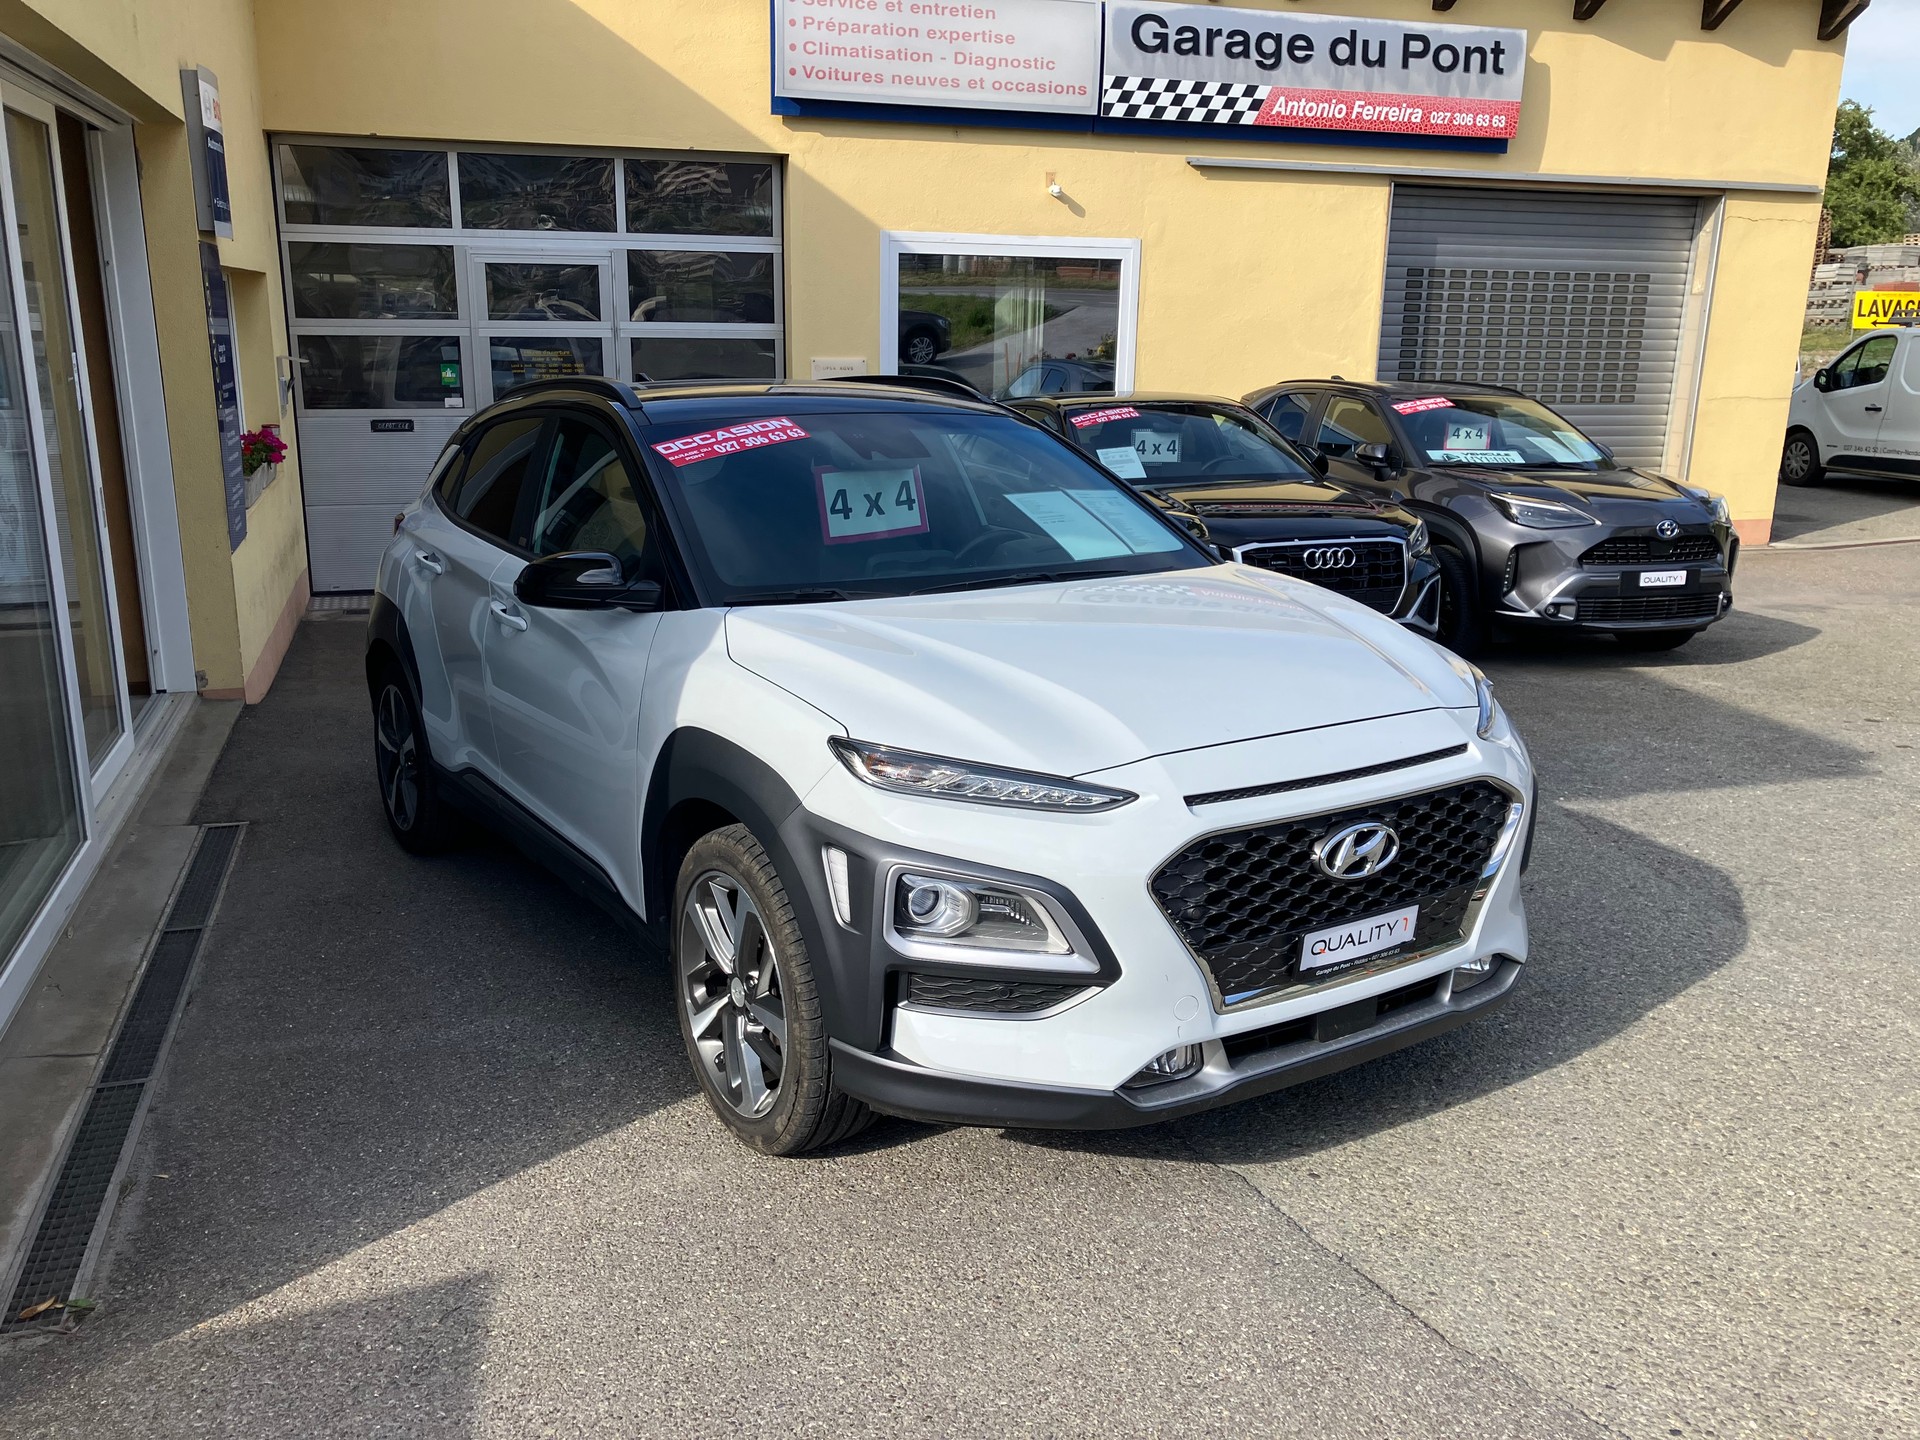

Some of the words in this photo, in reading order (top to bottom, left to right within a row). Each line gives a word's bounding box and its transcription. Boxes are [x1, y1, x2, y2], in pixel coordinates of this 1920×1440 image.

[885, 0, 903, 13] et
[910, 3, 996, 20] entretien
[803, 16, 919, 38] Préparation
[926, 28, 1016, 45] expertise
[802, 41, 933, 63] Climatisation
[954, 51, 1056, 71] Diagnostic
[1131, 13, 1314, 71] Garage
[1329, 29, 1387, 68] du
[1401, 33, 1506, 75] Pont
[802, 65, 884, 84] Voitures
[891, 74, 960, 88] neuves
[967, 77, 985, 90] et
[991, 80, 1088, 96] occasions
[1271, 96, 1347, 119] Antonio
[1351, 100, 1423, 123] Ferreira
[1430, 111, 1451, 125] 027
[1453, 112, 1474, 126] 306
[1475, 113, 1490, 127] 63
[1492, 115, 1506, 128] 63
[1857, 299, 1920, 318] LAVAG
[1070, 407, 1135, 423] OCCASION
[1391, 397, 1449, 410] OCCASION
[655, 418, 794, 454] OCCASION
[713, 440, 741, 454] 027
[740, 434, 769, 448] 306
[769, 431, 788, 442] 63
[788, 428, 806, 438] 63
[1453, 427, 1460, 439] 4
[1464, 430, 1473, 439] x
[1475, 427, 1483, 439] 4
[668, 450, 699, 461] GARAGE
[685, 453, 705, 461] PONT
[1136, 440, 1146, 455] 4
[1152, 443, 1162, 455] x
[1167, 440, 1177, 455] 4
[829, 488, 852, 520] 4
[863, 491, 886, 517] x
[895, 480, 916, 511] 4
[1311, 920, 1399, 955] QUALITY
